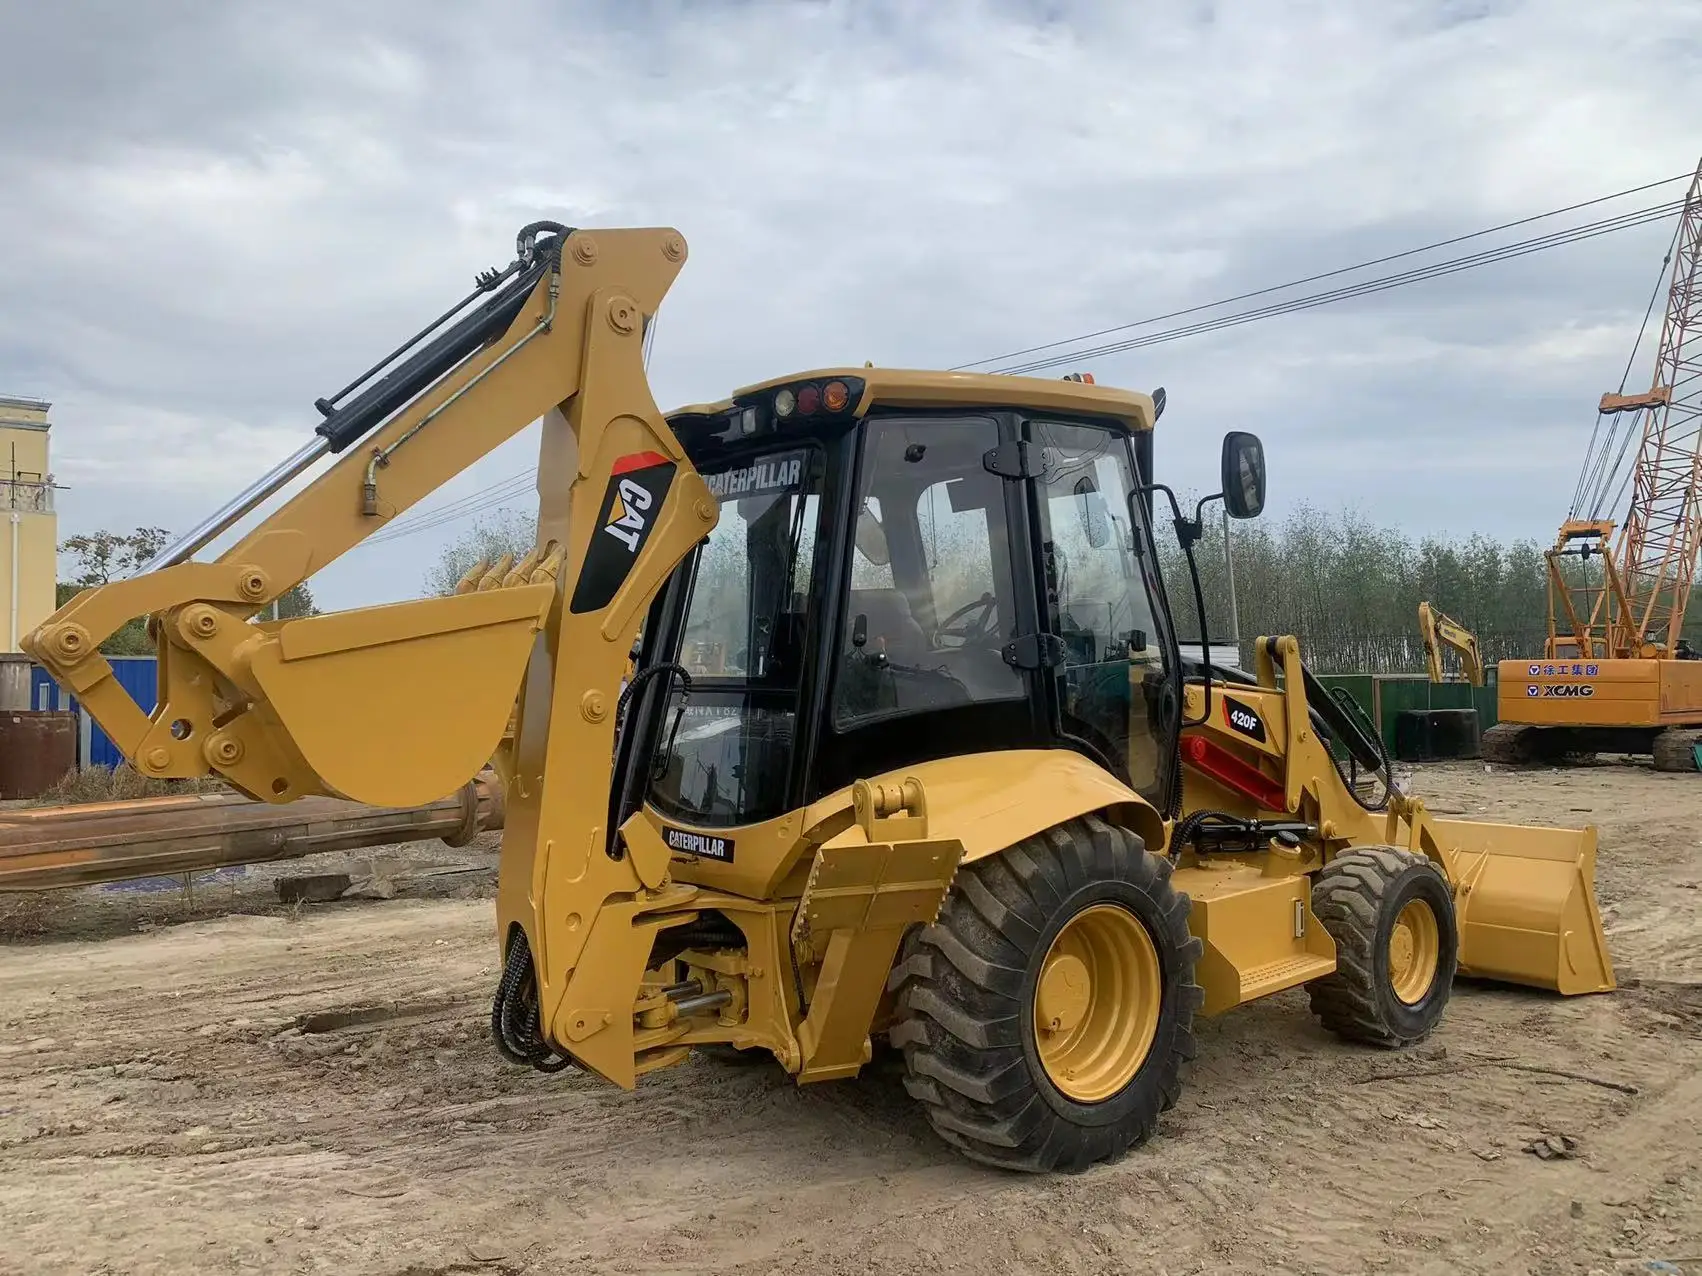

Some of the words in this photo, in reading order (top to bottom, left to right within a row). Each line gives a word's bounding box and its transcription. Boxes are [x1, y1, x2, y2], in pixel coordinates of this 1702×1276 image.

[708, 460, 801, 494] CATERPILLAR
[604, 478, 652, 553] CAT
[1543, 664, 1599, 676] 徐工集团
[1543, 685, 1594, 697] XCMG
[1231, 710, 1257, 730] 420F
[669, 830, 725, 857] CATERPILLAR
